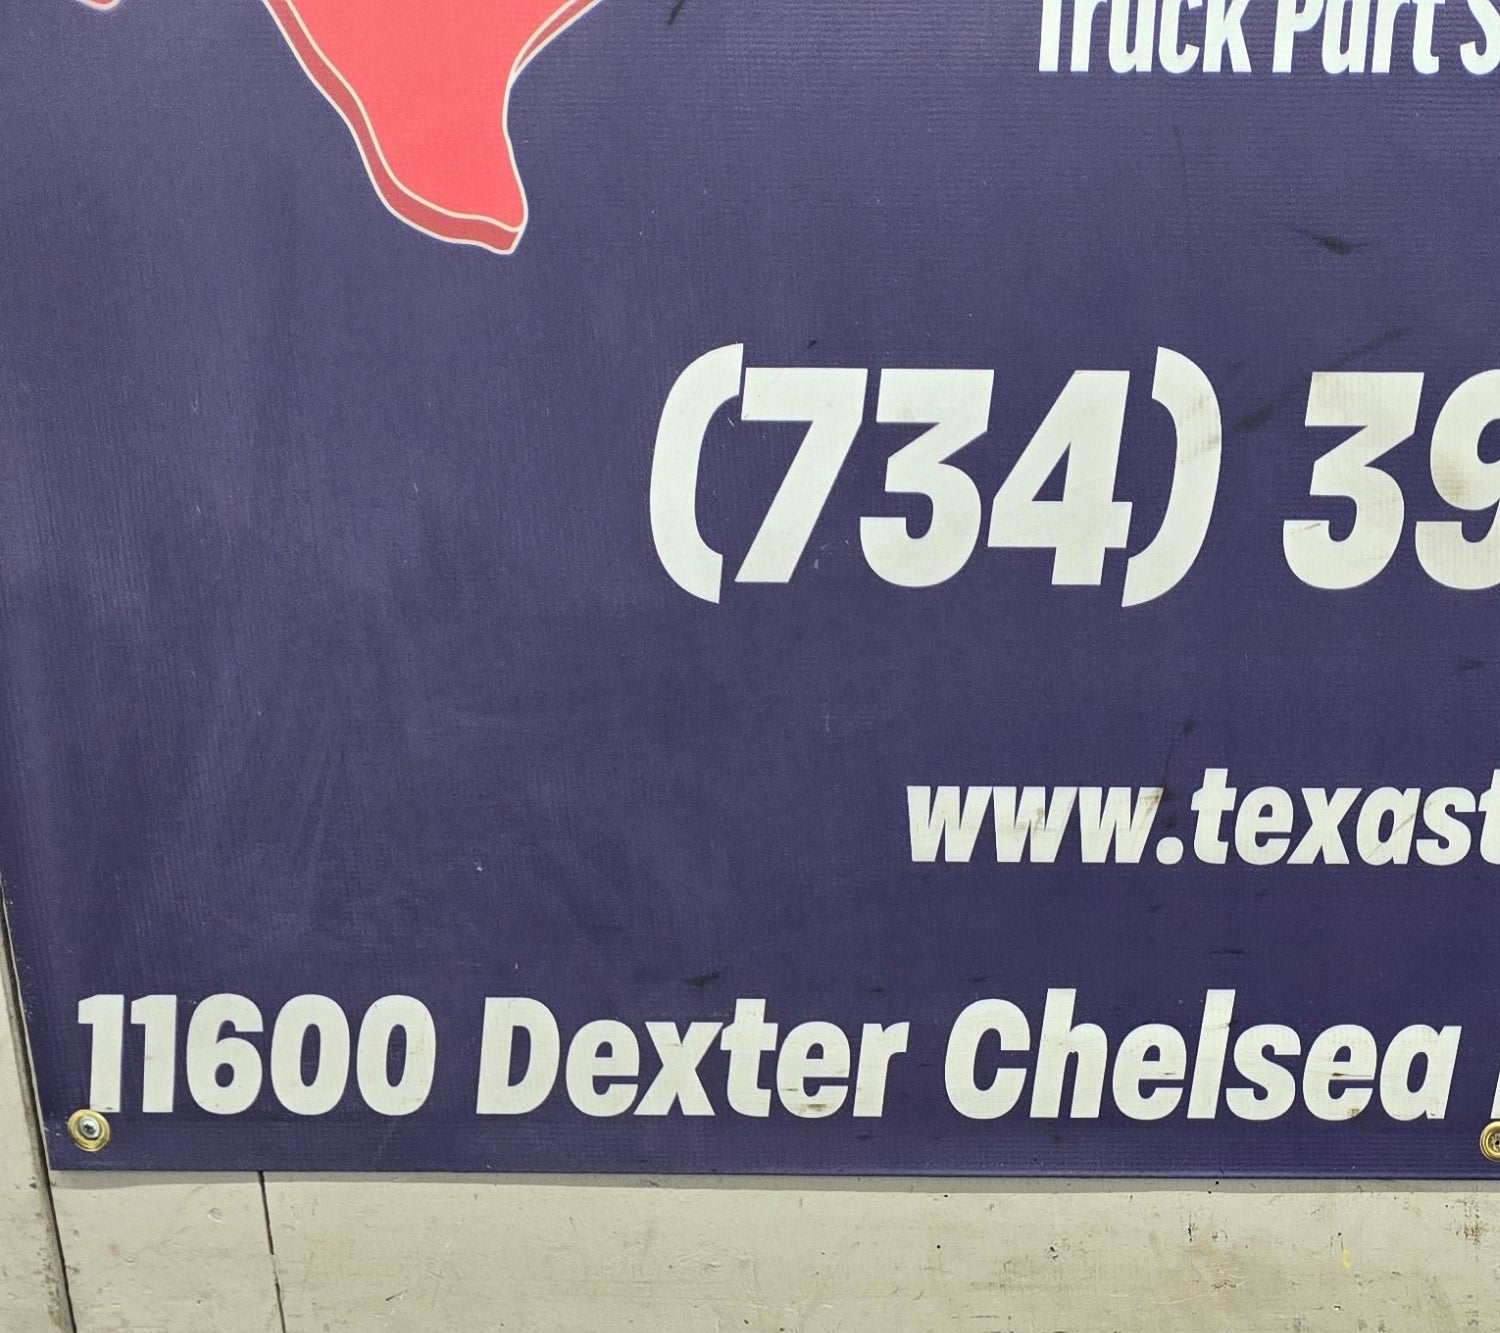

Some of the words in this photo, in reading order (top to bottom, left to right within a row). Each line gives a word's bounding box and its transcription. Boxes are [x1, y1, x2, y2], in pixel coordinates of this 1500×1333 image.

[1039, 0, 1252, 74] Truck
[1271, 0, 1446, 76] Part
[649, 343, 1222, 608] (734)
[75, 993, 436, 1116] 11600
[476, 996, 910, 1119] Dexter
[944, 987, 1463, 1121] Chelsea
